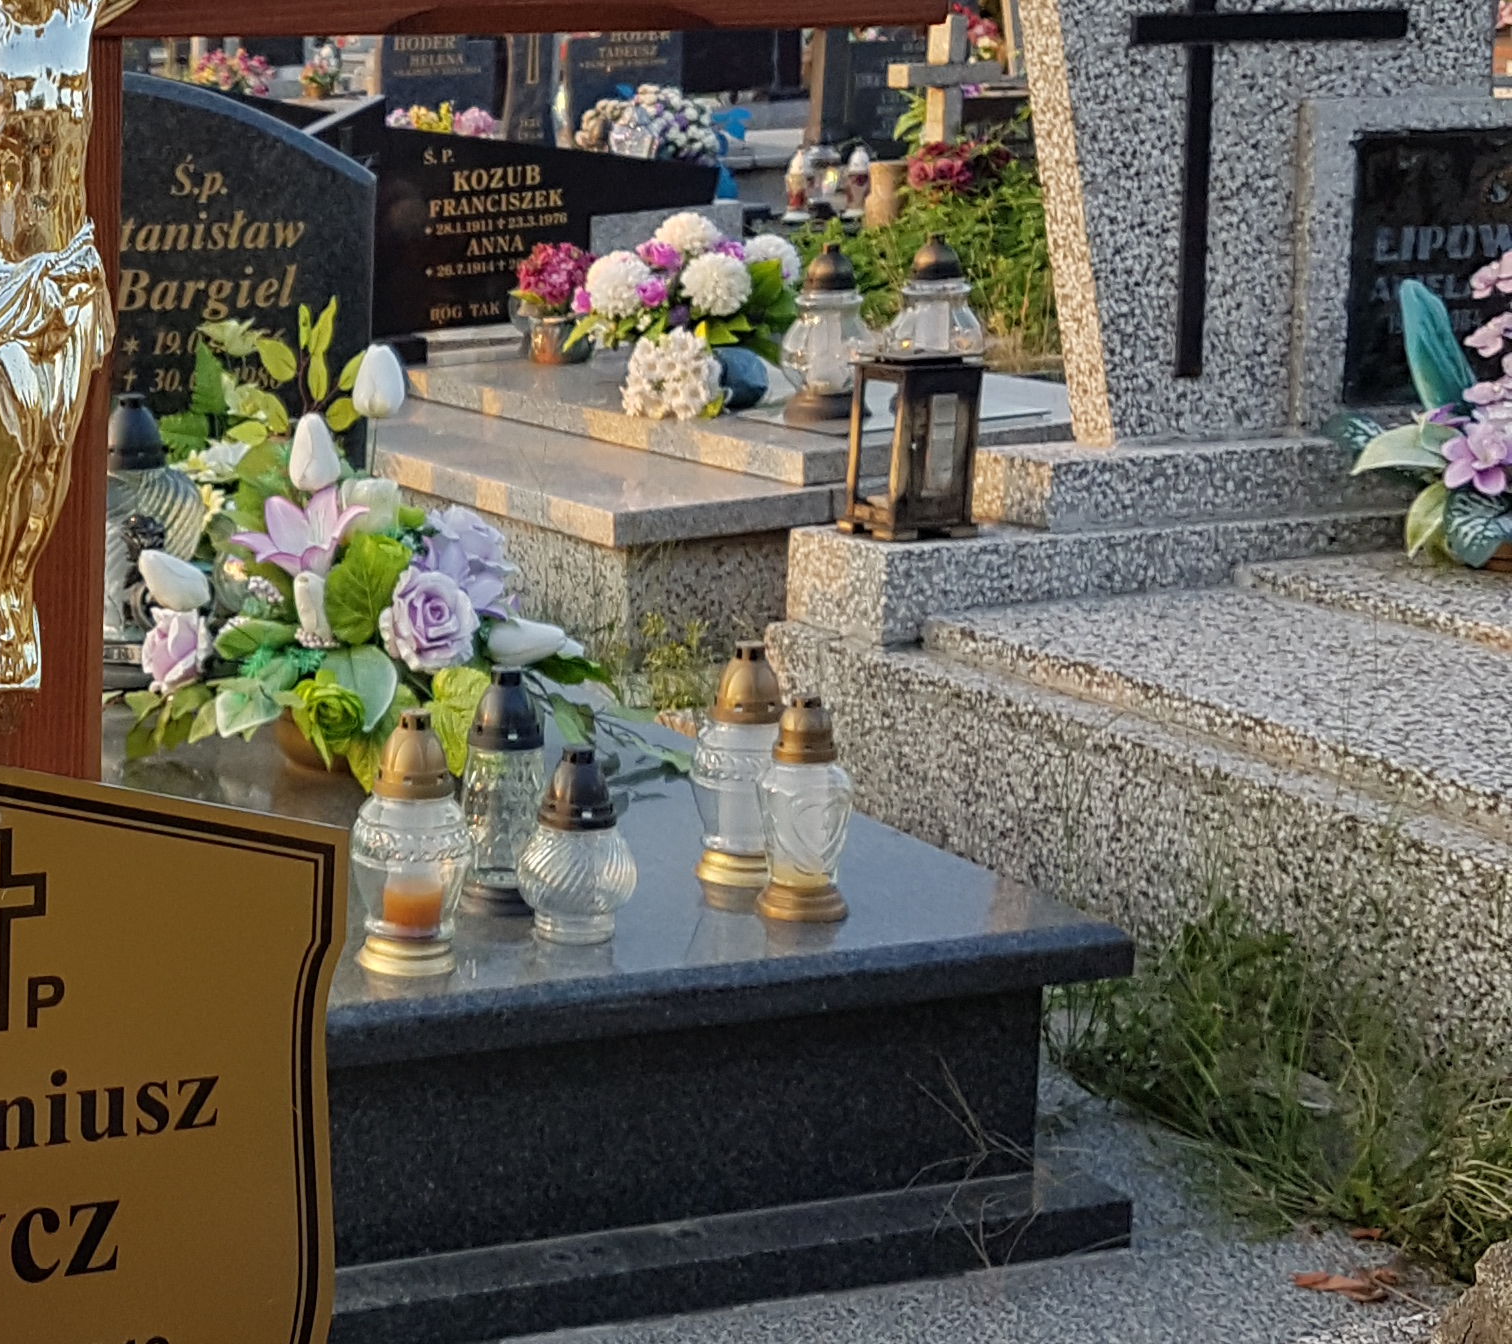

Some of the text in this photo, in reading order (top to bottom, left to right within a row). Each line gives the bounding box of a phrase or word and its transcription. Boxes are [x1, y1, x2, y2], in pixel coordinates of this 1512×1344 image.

[170, 154, 229, 204] Ś.p.
[453, 164, 542, 193] KOZUB
[429, 188, 564, 218] FRANCISZEK
[119, 210, 306, 252] tanisław
[466, 234, 525, 257] ANNA
[118, 263, 299, 321] Bargiel
[469, 301, 501, 318] TAK
[26, 975, 65, 1029] P
